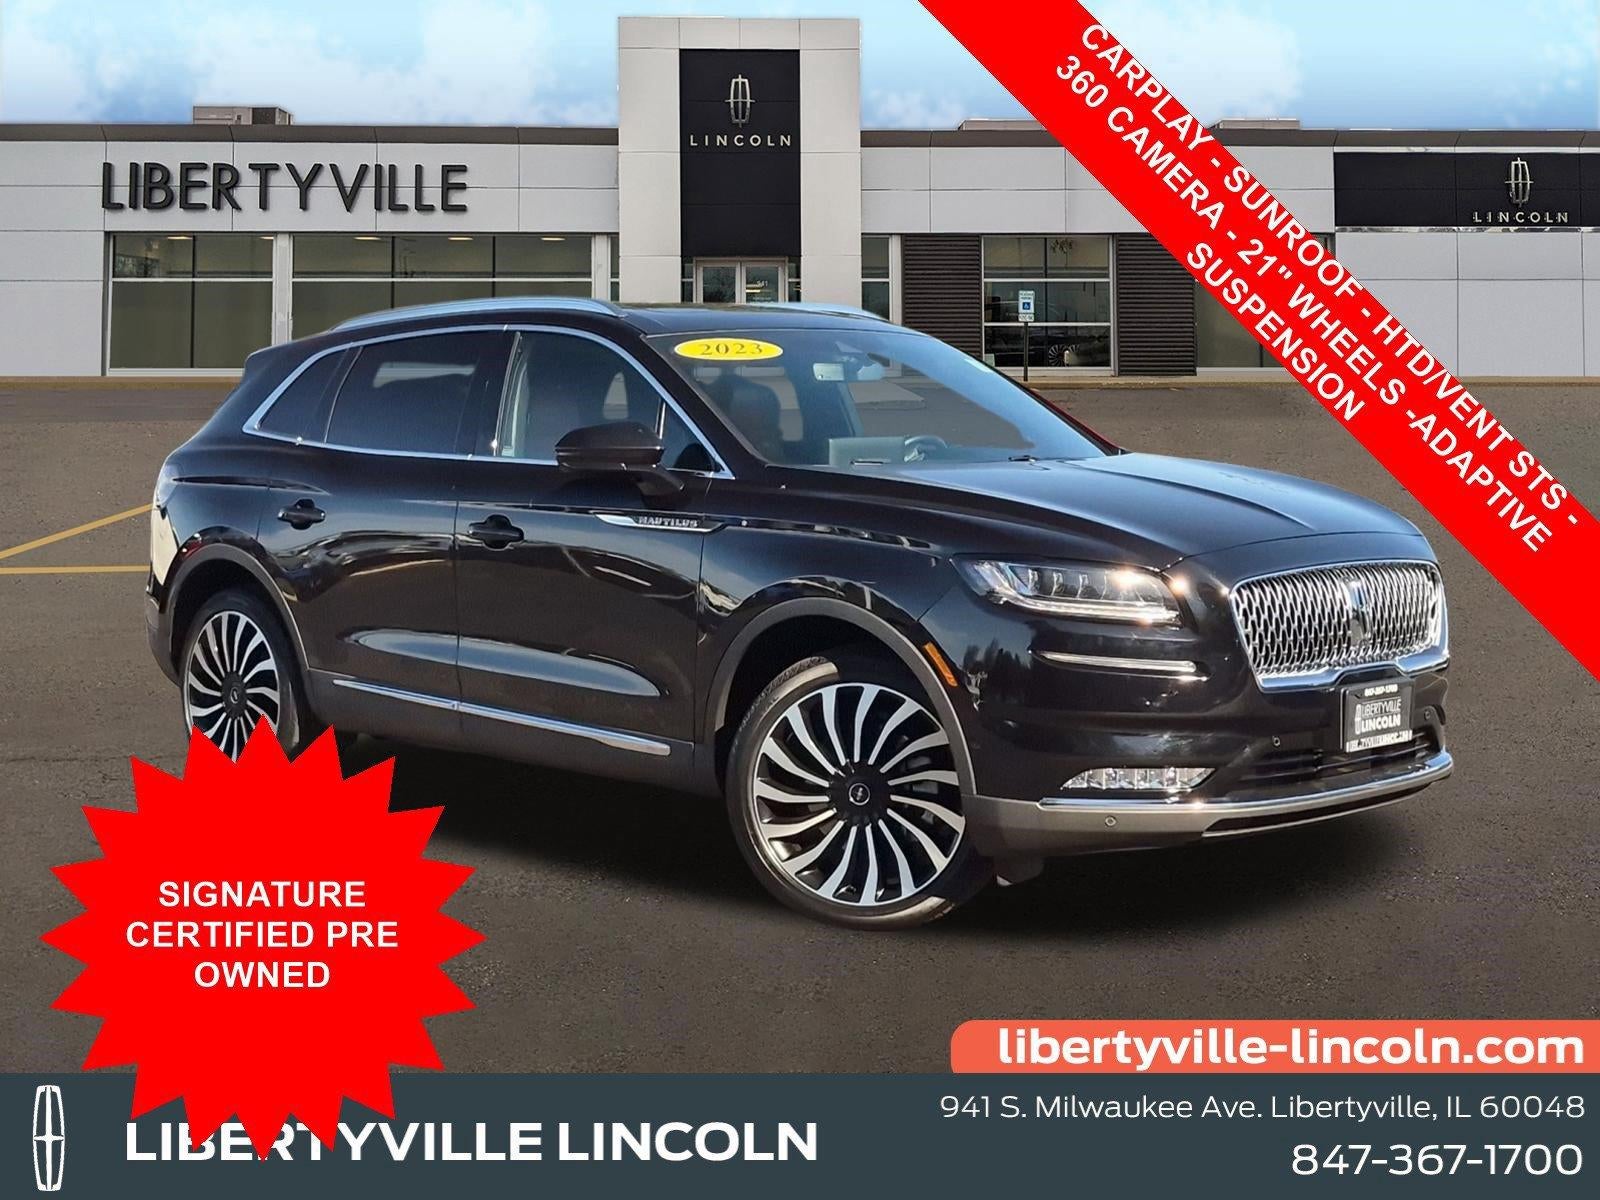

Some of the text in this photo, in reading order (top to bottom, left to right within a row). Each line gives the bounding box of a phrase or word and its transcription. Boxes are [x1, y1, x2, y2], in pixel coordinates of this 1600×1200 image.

[690, 134, 792, 147] LINCOLN
[101, 161, 469, 213] LIBERTYVILLE
[1473, 211, 1569, 223] LINCOLN
[699, 342, 764, 356] 2023
[638, 515, 698, 528] NAUTILUS
[1361, 699, 1402, 719] LIBERTYVILLE
[1361, 714, 1401, 733] LINCOLN
